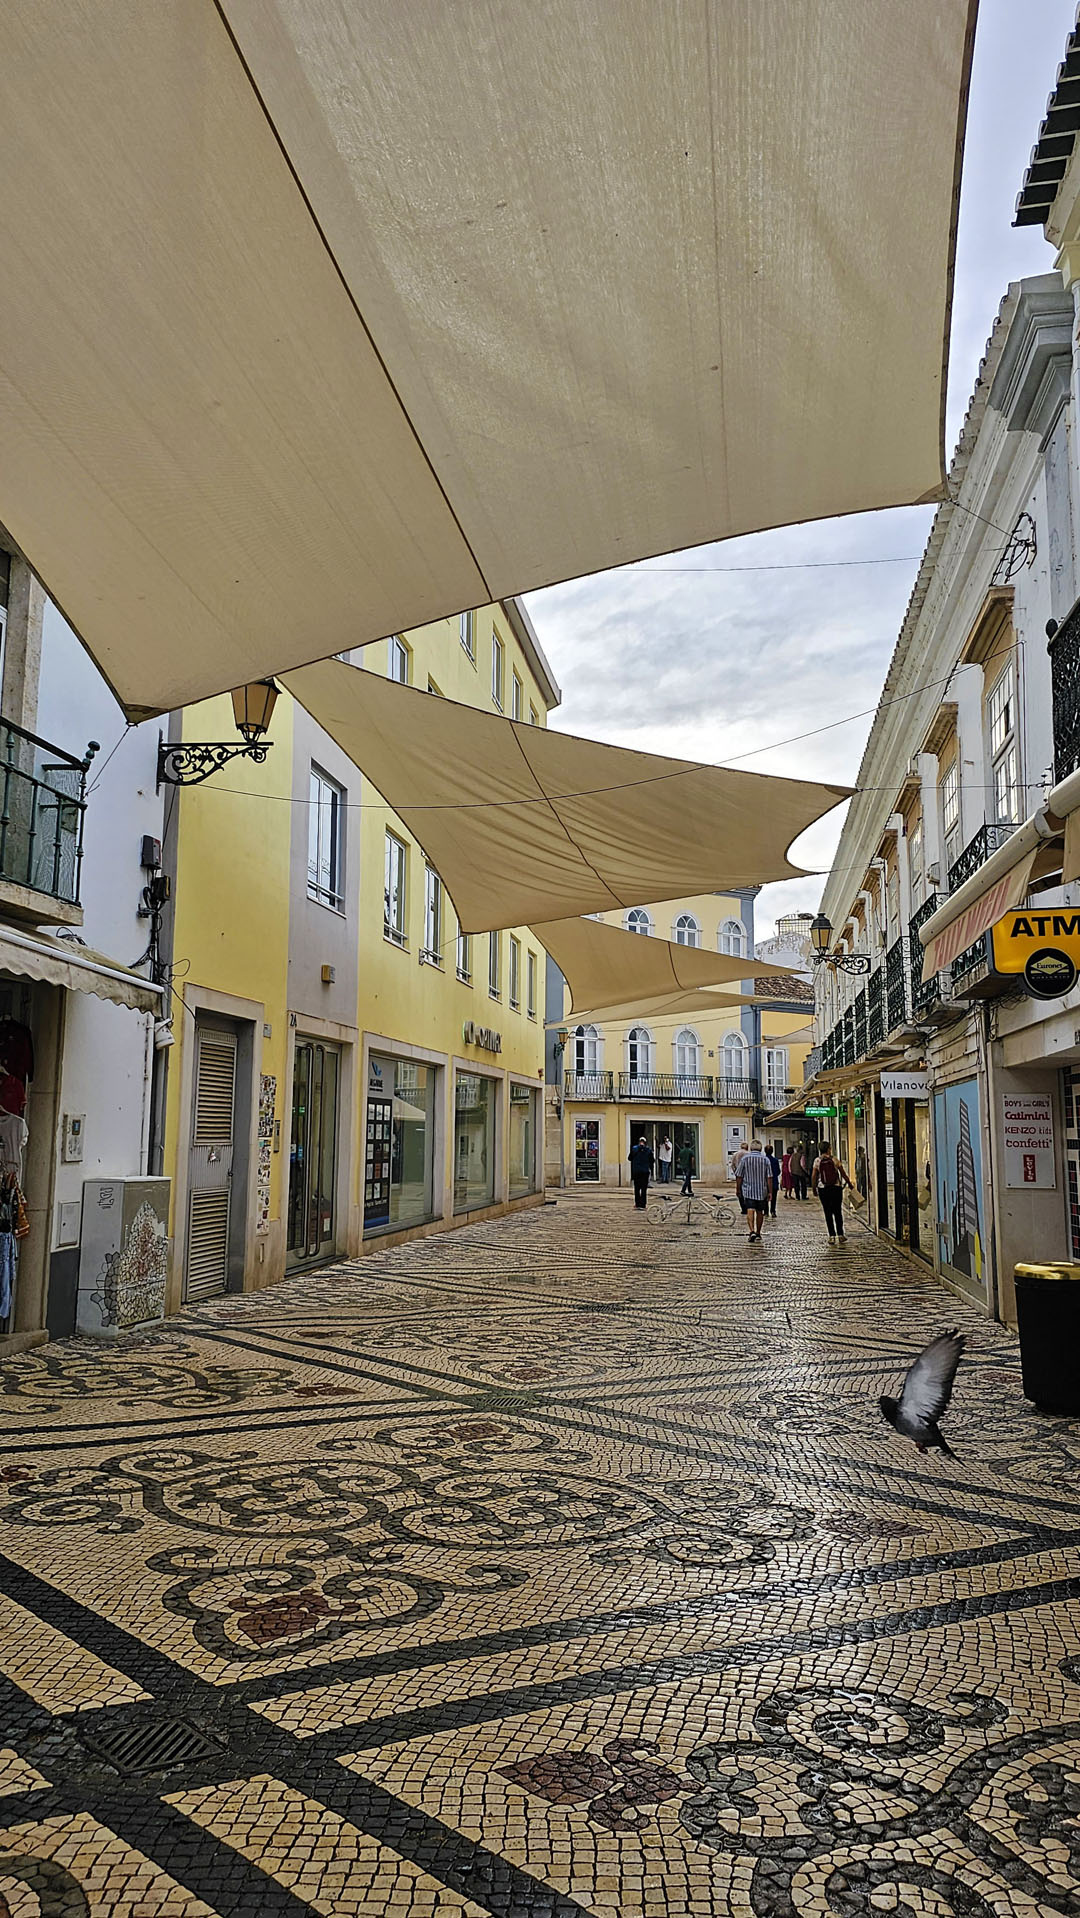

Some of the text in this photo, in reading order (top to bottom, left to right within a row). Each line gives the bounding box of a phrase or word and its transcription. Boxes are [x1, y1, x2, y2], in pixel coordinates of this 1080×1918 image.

[1010, 914, 1080, 937] ATM
[1036, 962, 1063, 970] Euronet
[1005, 1111, 1050, 1120] Catimini
[1005, 1126, 1052, 1135] KENZO kids
